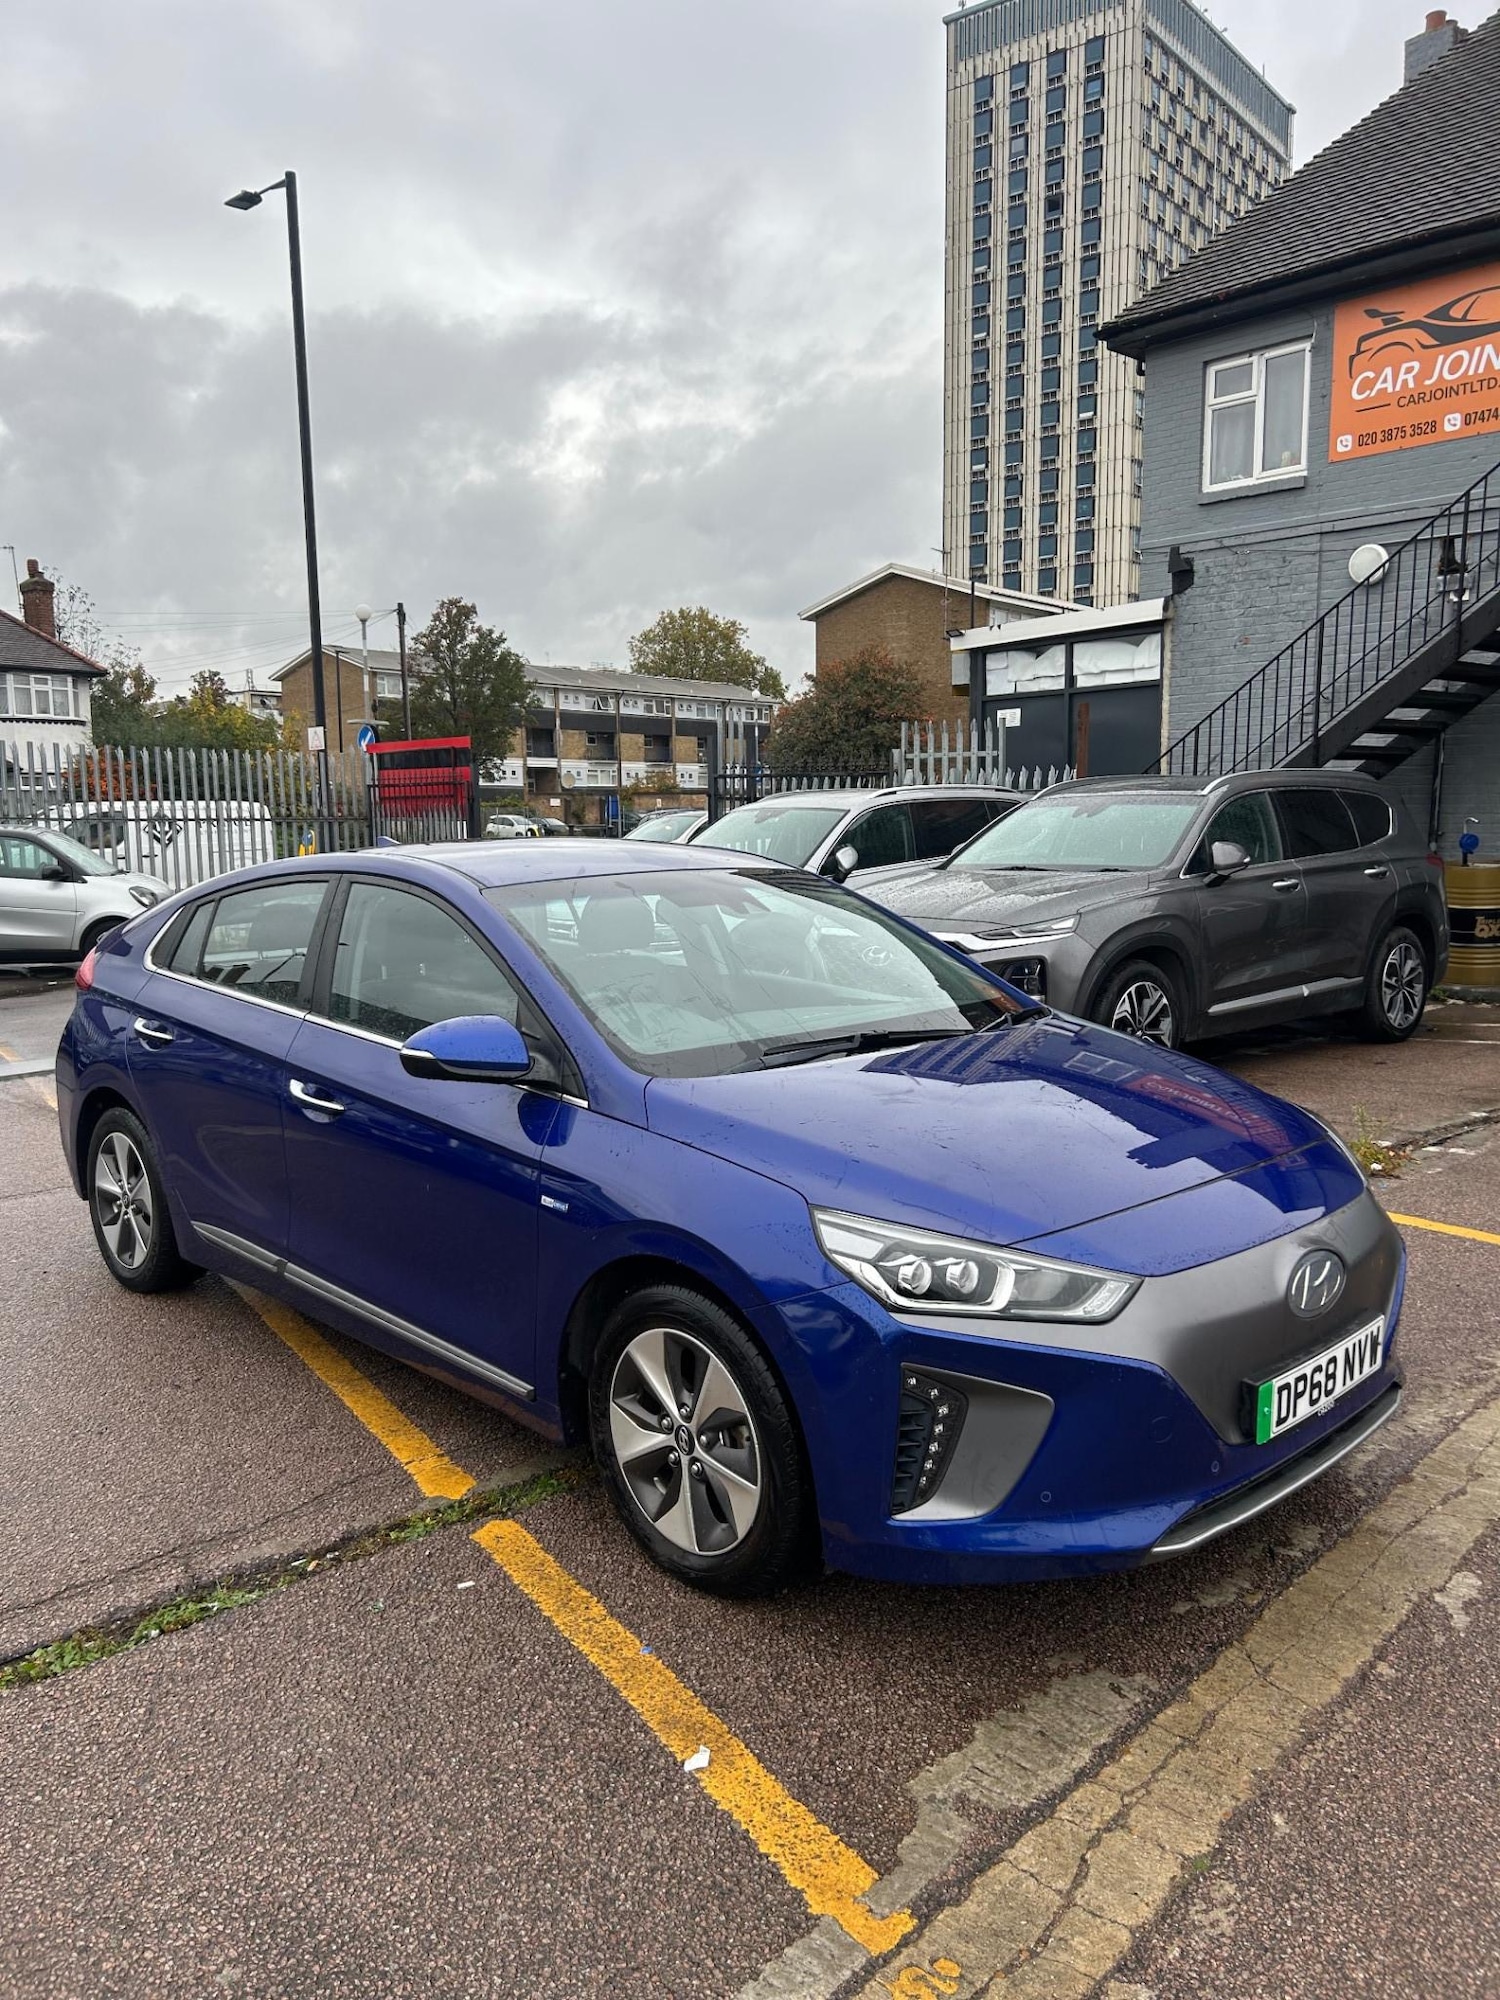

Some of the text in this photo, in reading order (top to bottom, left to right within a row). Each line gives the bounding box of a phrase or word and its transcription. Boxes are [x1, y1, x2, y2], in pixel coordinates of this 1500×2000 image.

[1351, 344, 1500, 400] CAR JOIN
[1358, 420, 1437, 447] 020 3875 3528
[1464, 407, 1499, 426] 07474
[1275, 1326, 1381, 1428] DP68 NVW
